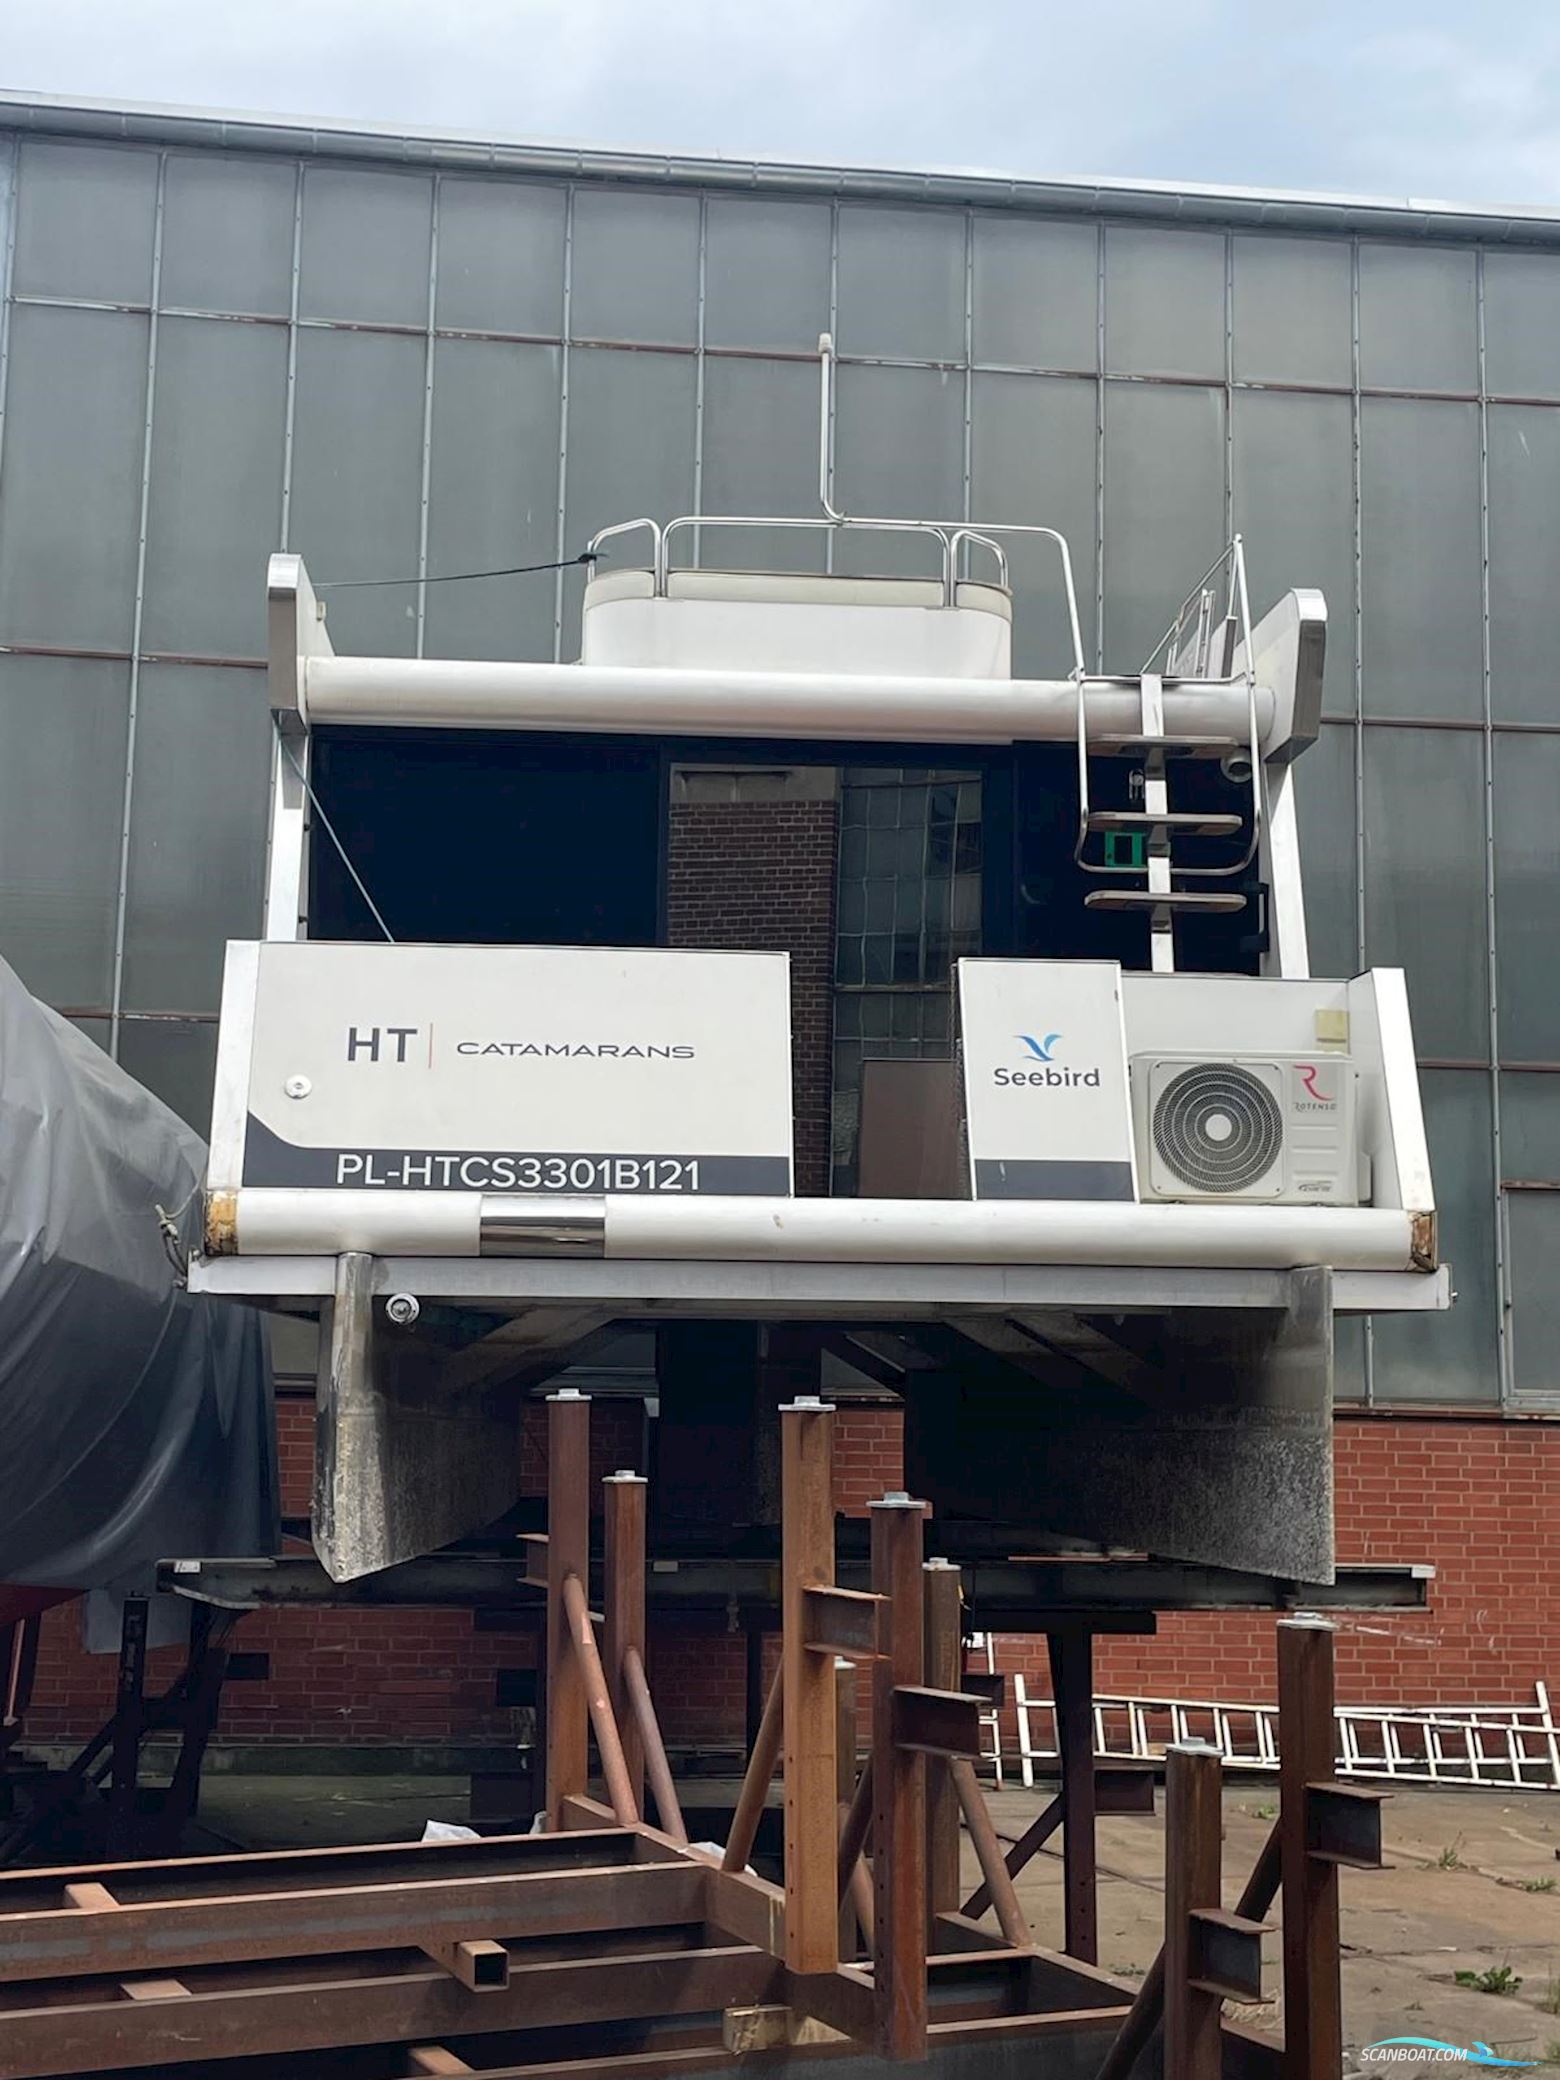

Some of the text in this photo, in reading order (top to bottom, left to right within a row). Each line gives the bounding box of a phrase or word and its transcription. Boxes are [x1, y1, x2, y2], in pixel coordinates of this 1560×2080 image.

[347, 1027, 695, 1063] HT CATAMARANS
[993, 1067, 1101, 1087] Seebird
[336, 1154, 700, 1191] PL-HTCS3301B121
